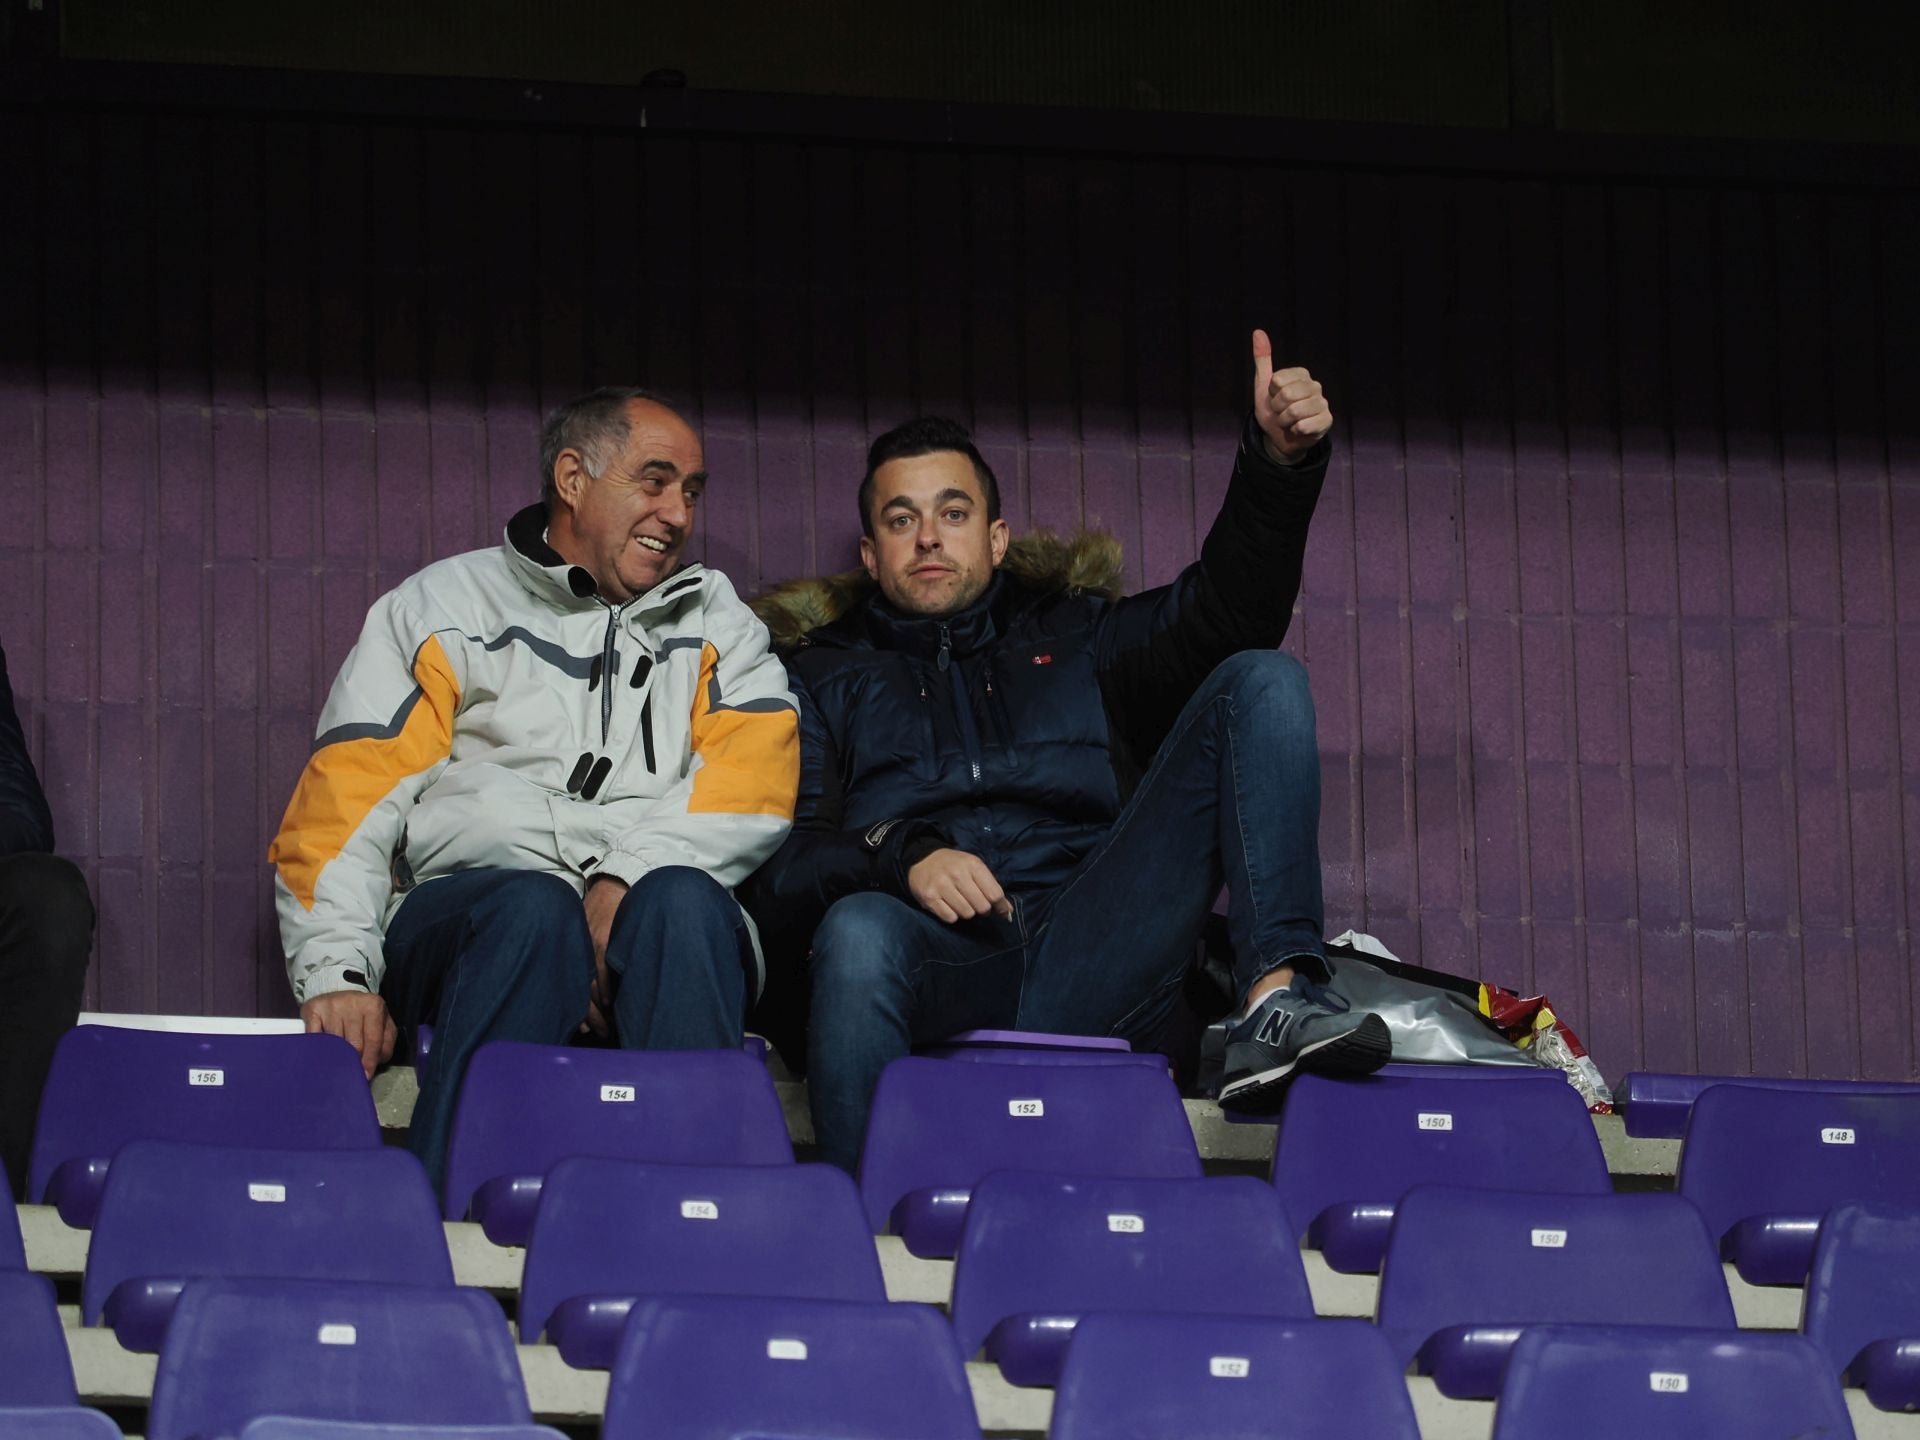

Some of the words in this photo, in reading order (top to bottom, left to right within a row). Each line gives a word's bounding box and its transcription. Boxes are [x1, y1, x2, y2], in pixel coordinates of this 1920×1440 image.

[1256, 1008, 1293, 1047] N
[197, 1073, 216, 1083] 156
[608, 1089, 627, 1100] 154
[1017, 1104, 1036, 1114] 152
[1425, 1117, 1445, 1127] 150
[1828, 1132, 1847, 1141] 148
[690, 1206, 709, 1216] 154
[1116, 1220, 1135, 1230] 152
[1539, 1234, 1559, 1244] 150
[1659, 1378, 1680, 1390] 150
